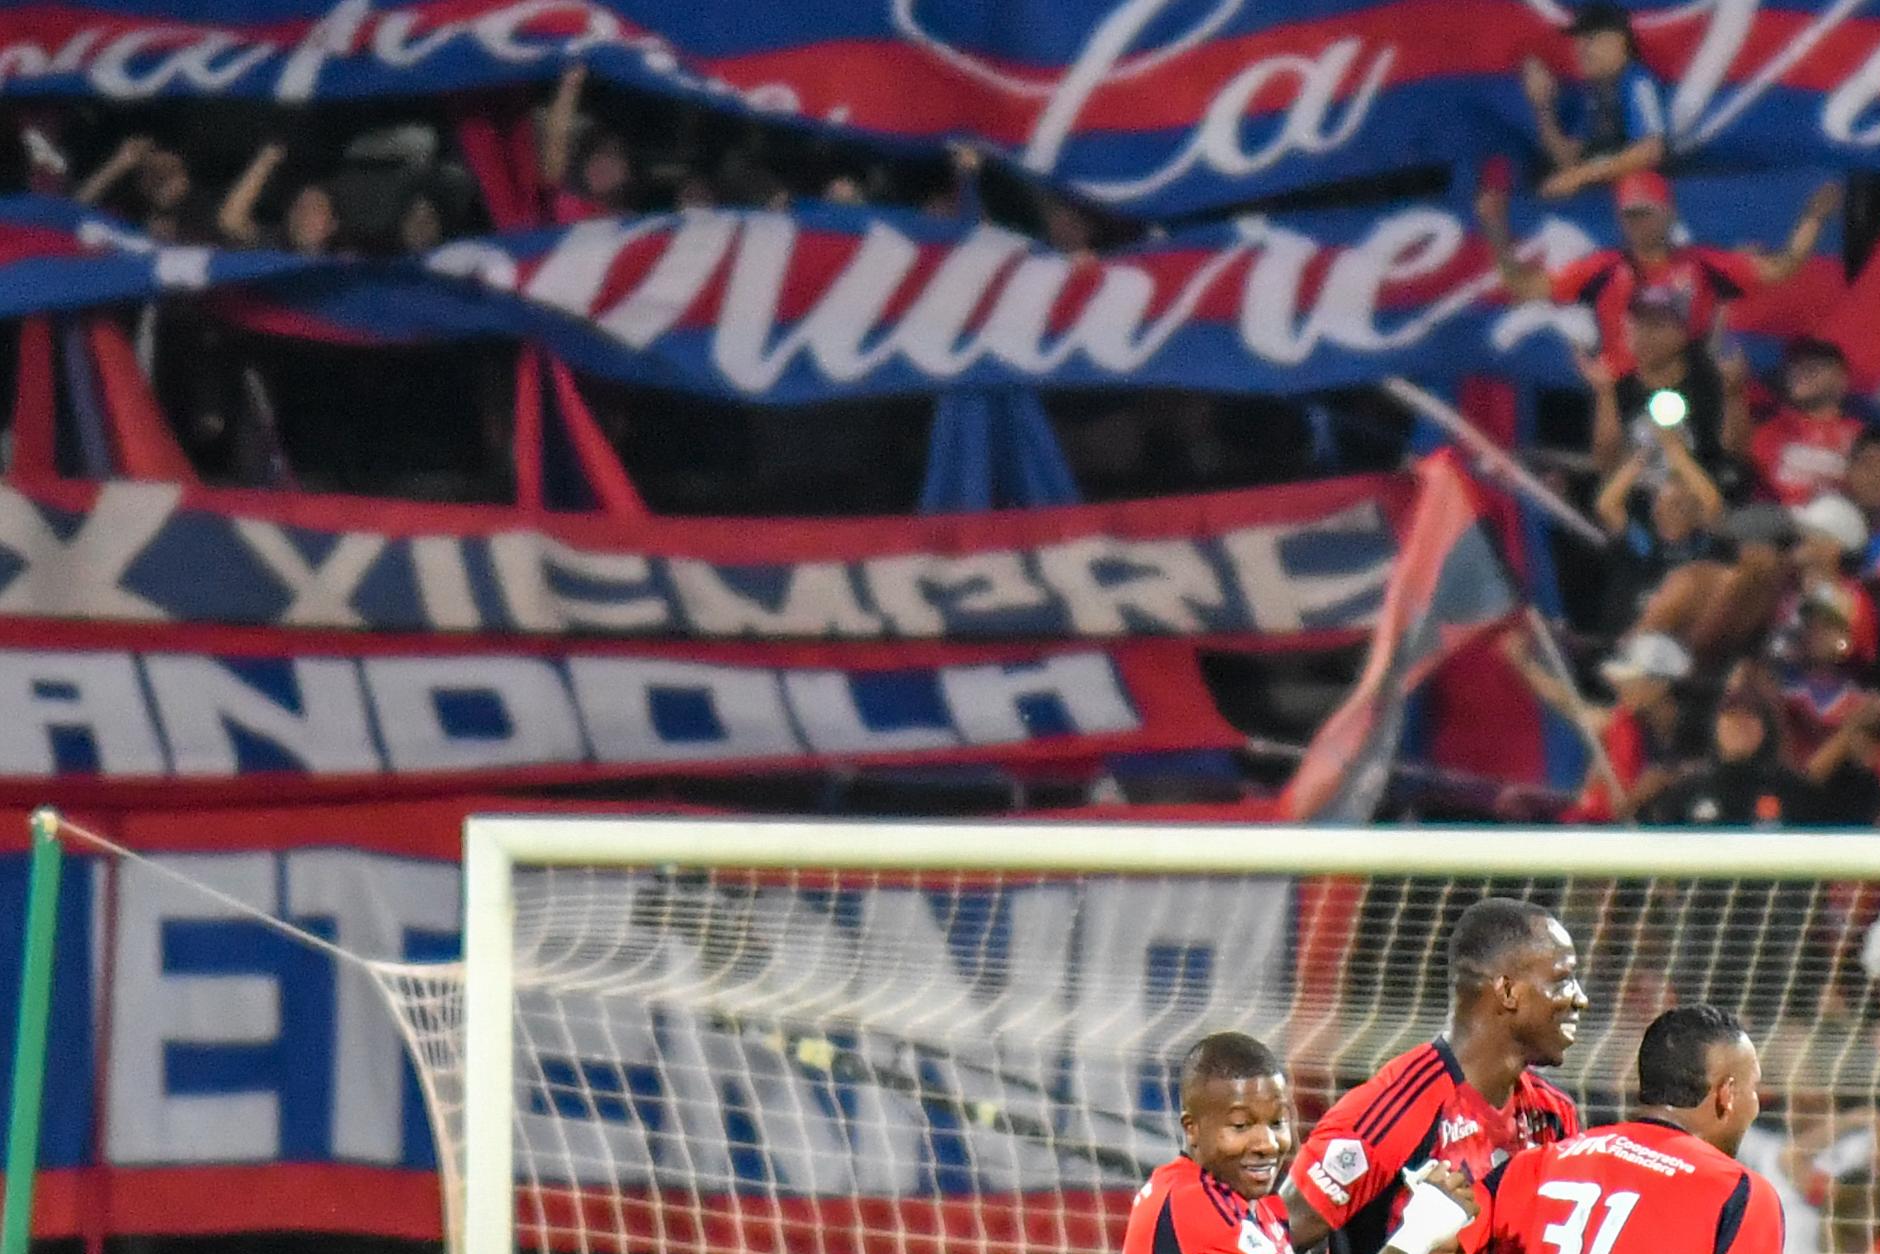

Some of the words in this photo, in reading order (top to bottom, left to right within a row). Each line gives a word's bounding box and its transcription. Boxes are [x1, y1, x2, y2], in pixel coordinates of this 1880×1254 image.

[1441, 1113, 1479, 1150] Pilsen
[1606, 1144, 1677, 1177] Financiera
[1614, 1135, 1697, 1175] Cooperativa
